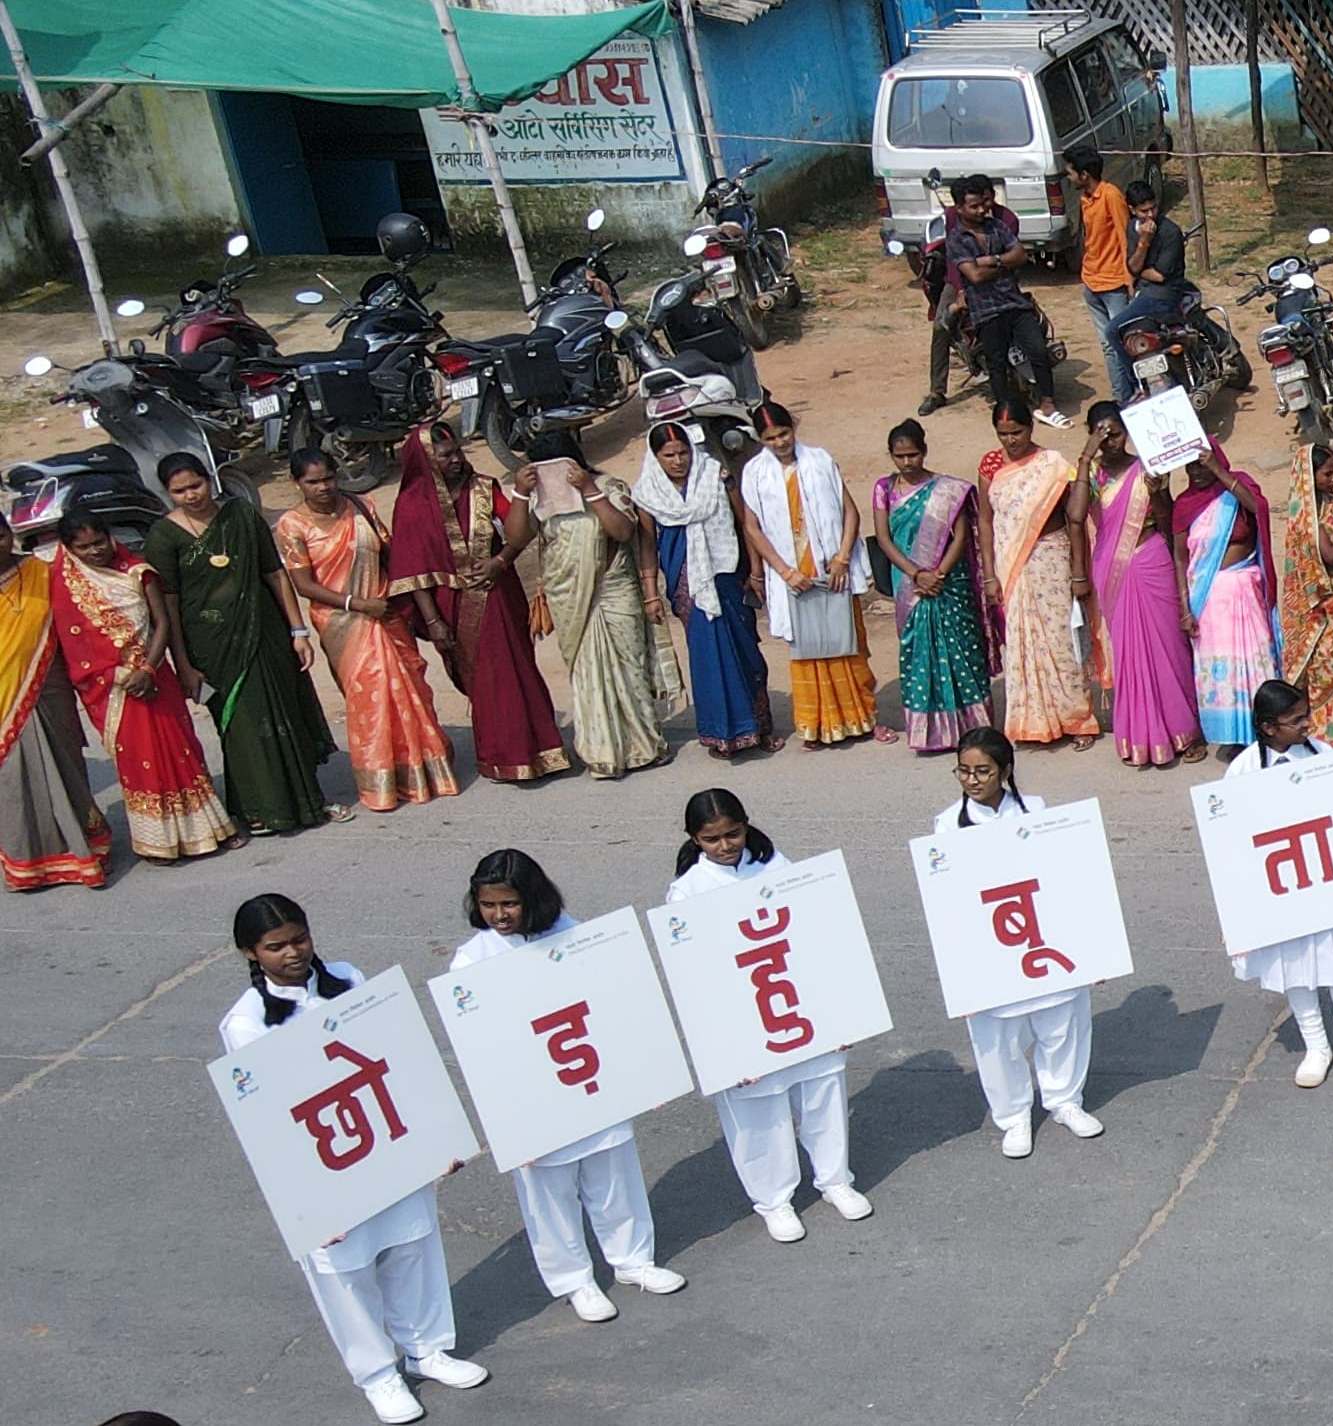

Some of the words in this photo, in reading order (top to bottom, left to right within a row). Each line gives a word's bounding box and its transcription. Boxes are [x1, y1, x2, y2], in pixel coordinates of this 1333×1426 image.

[735, 906, 814, 1053] हुँ
[980, 879, 1076, 979] बू
[531, 1000, 600, 1095] ड़
[290, 1040, 408, 1171] छो
